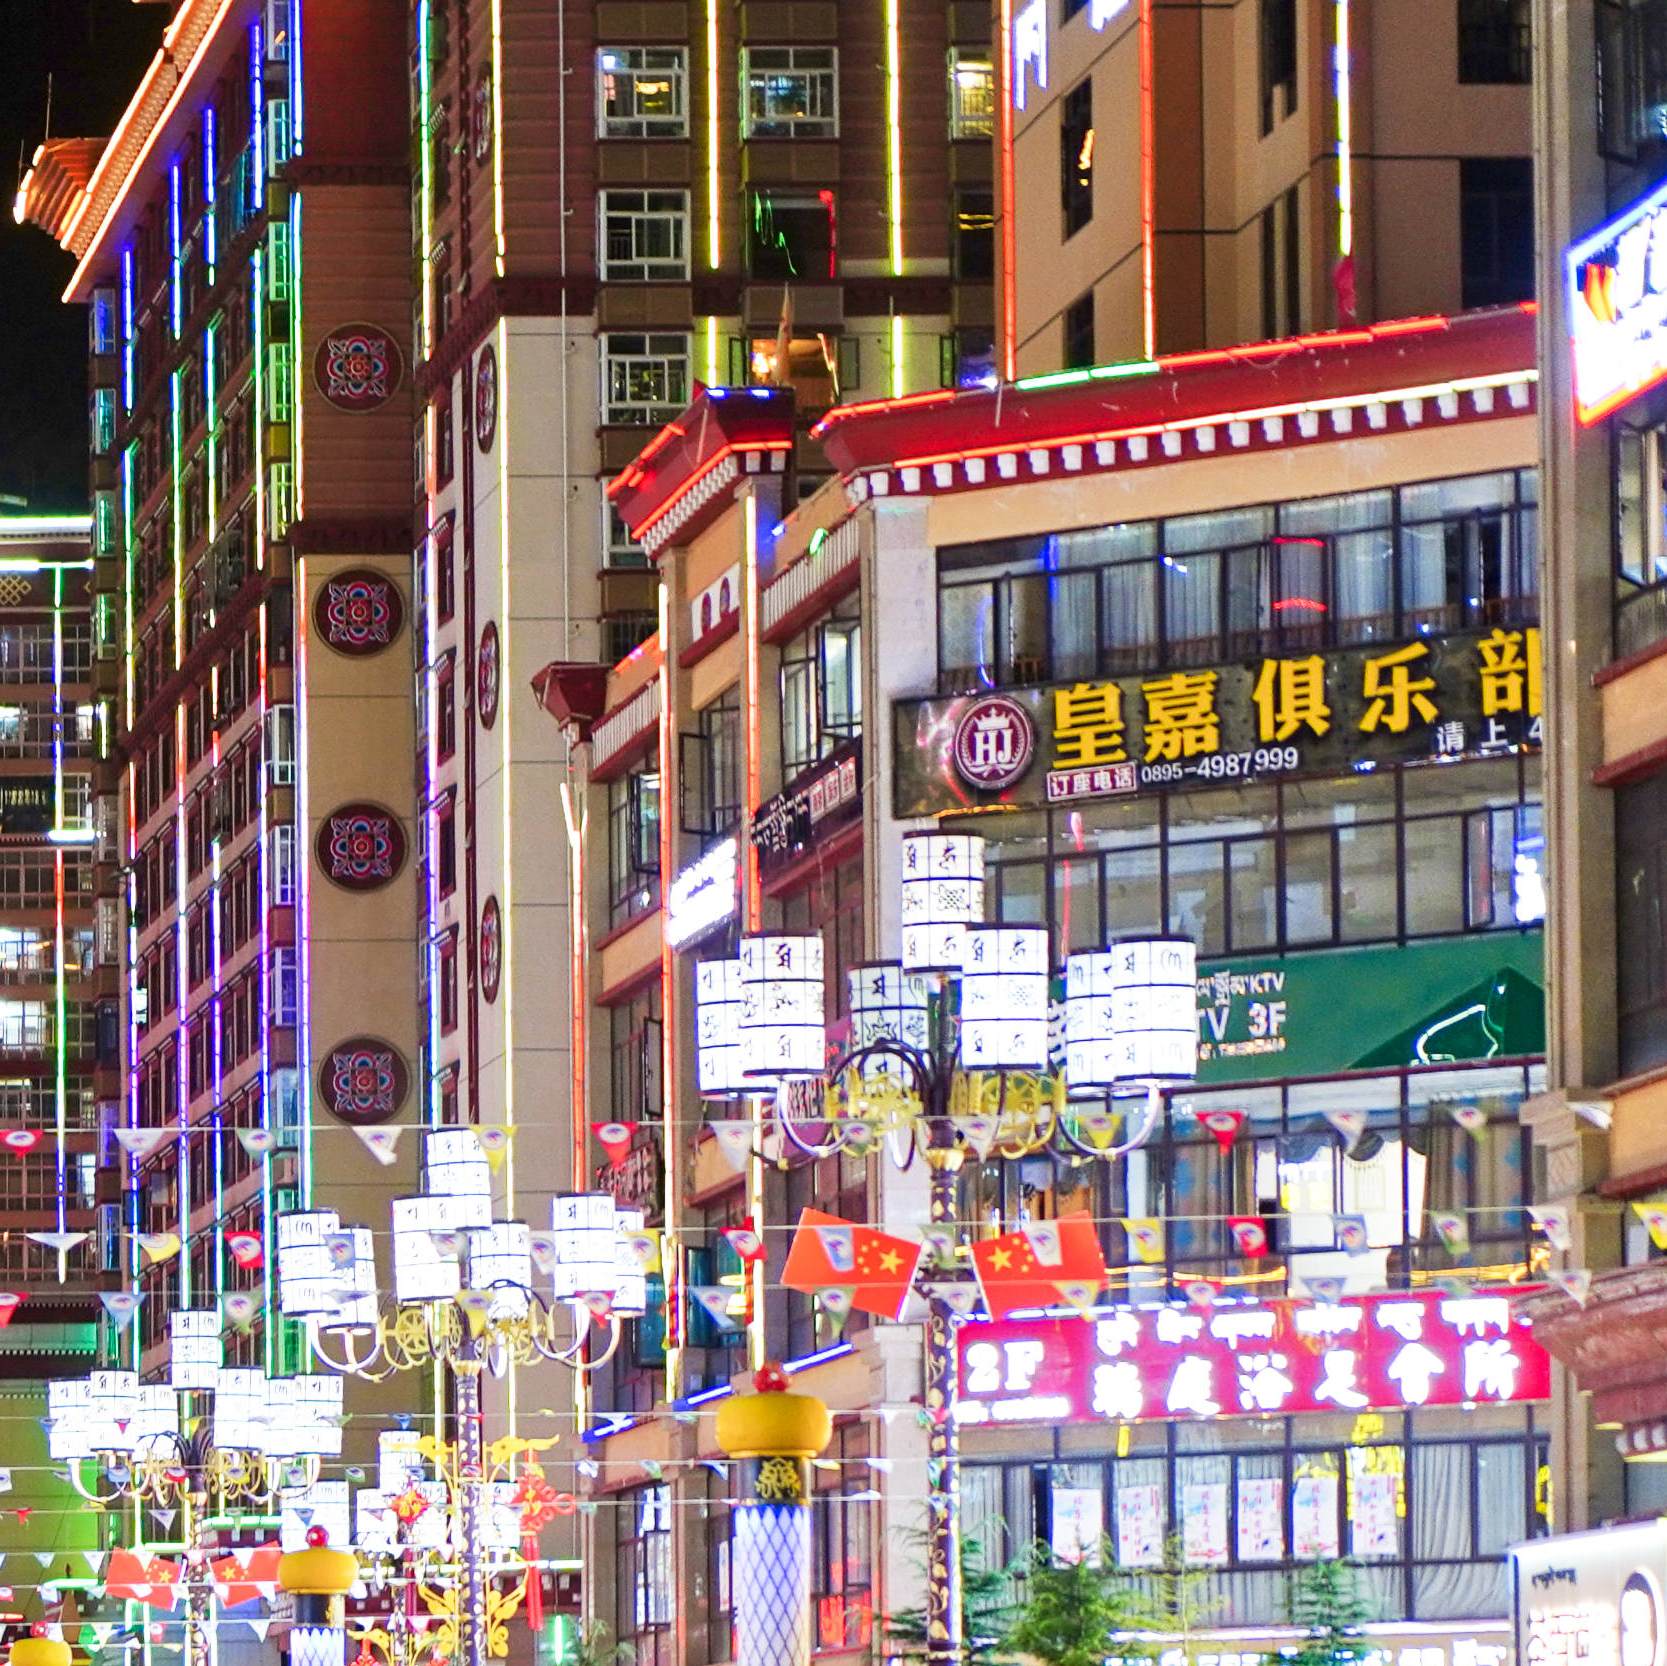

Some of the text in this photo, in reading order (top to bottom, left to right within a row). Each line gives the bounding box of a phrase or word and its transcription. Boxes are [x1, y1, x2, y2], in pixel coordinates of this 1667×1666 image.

[1052, 628, 1543, 770] 皇嘉俱乐部
[1050, 767, 1135, 798] 订座电话
[1141, 747, 1299, 783] 0895-4987999
[1248, 1001, 1287, 1037] 3F
[966, 1341, 1044, 1393] 2F
